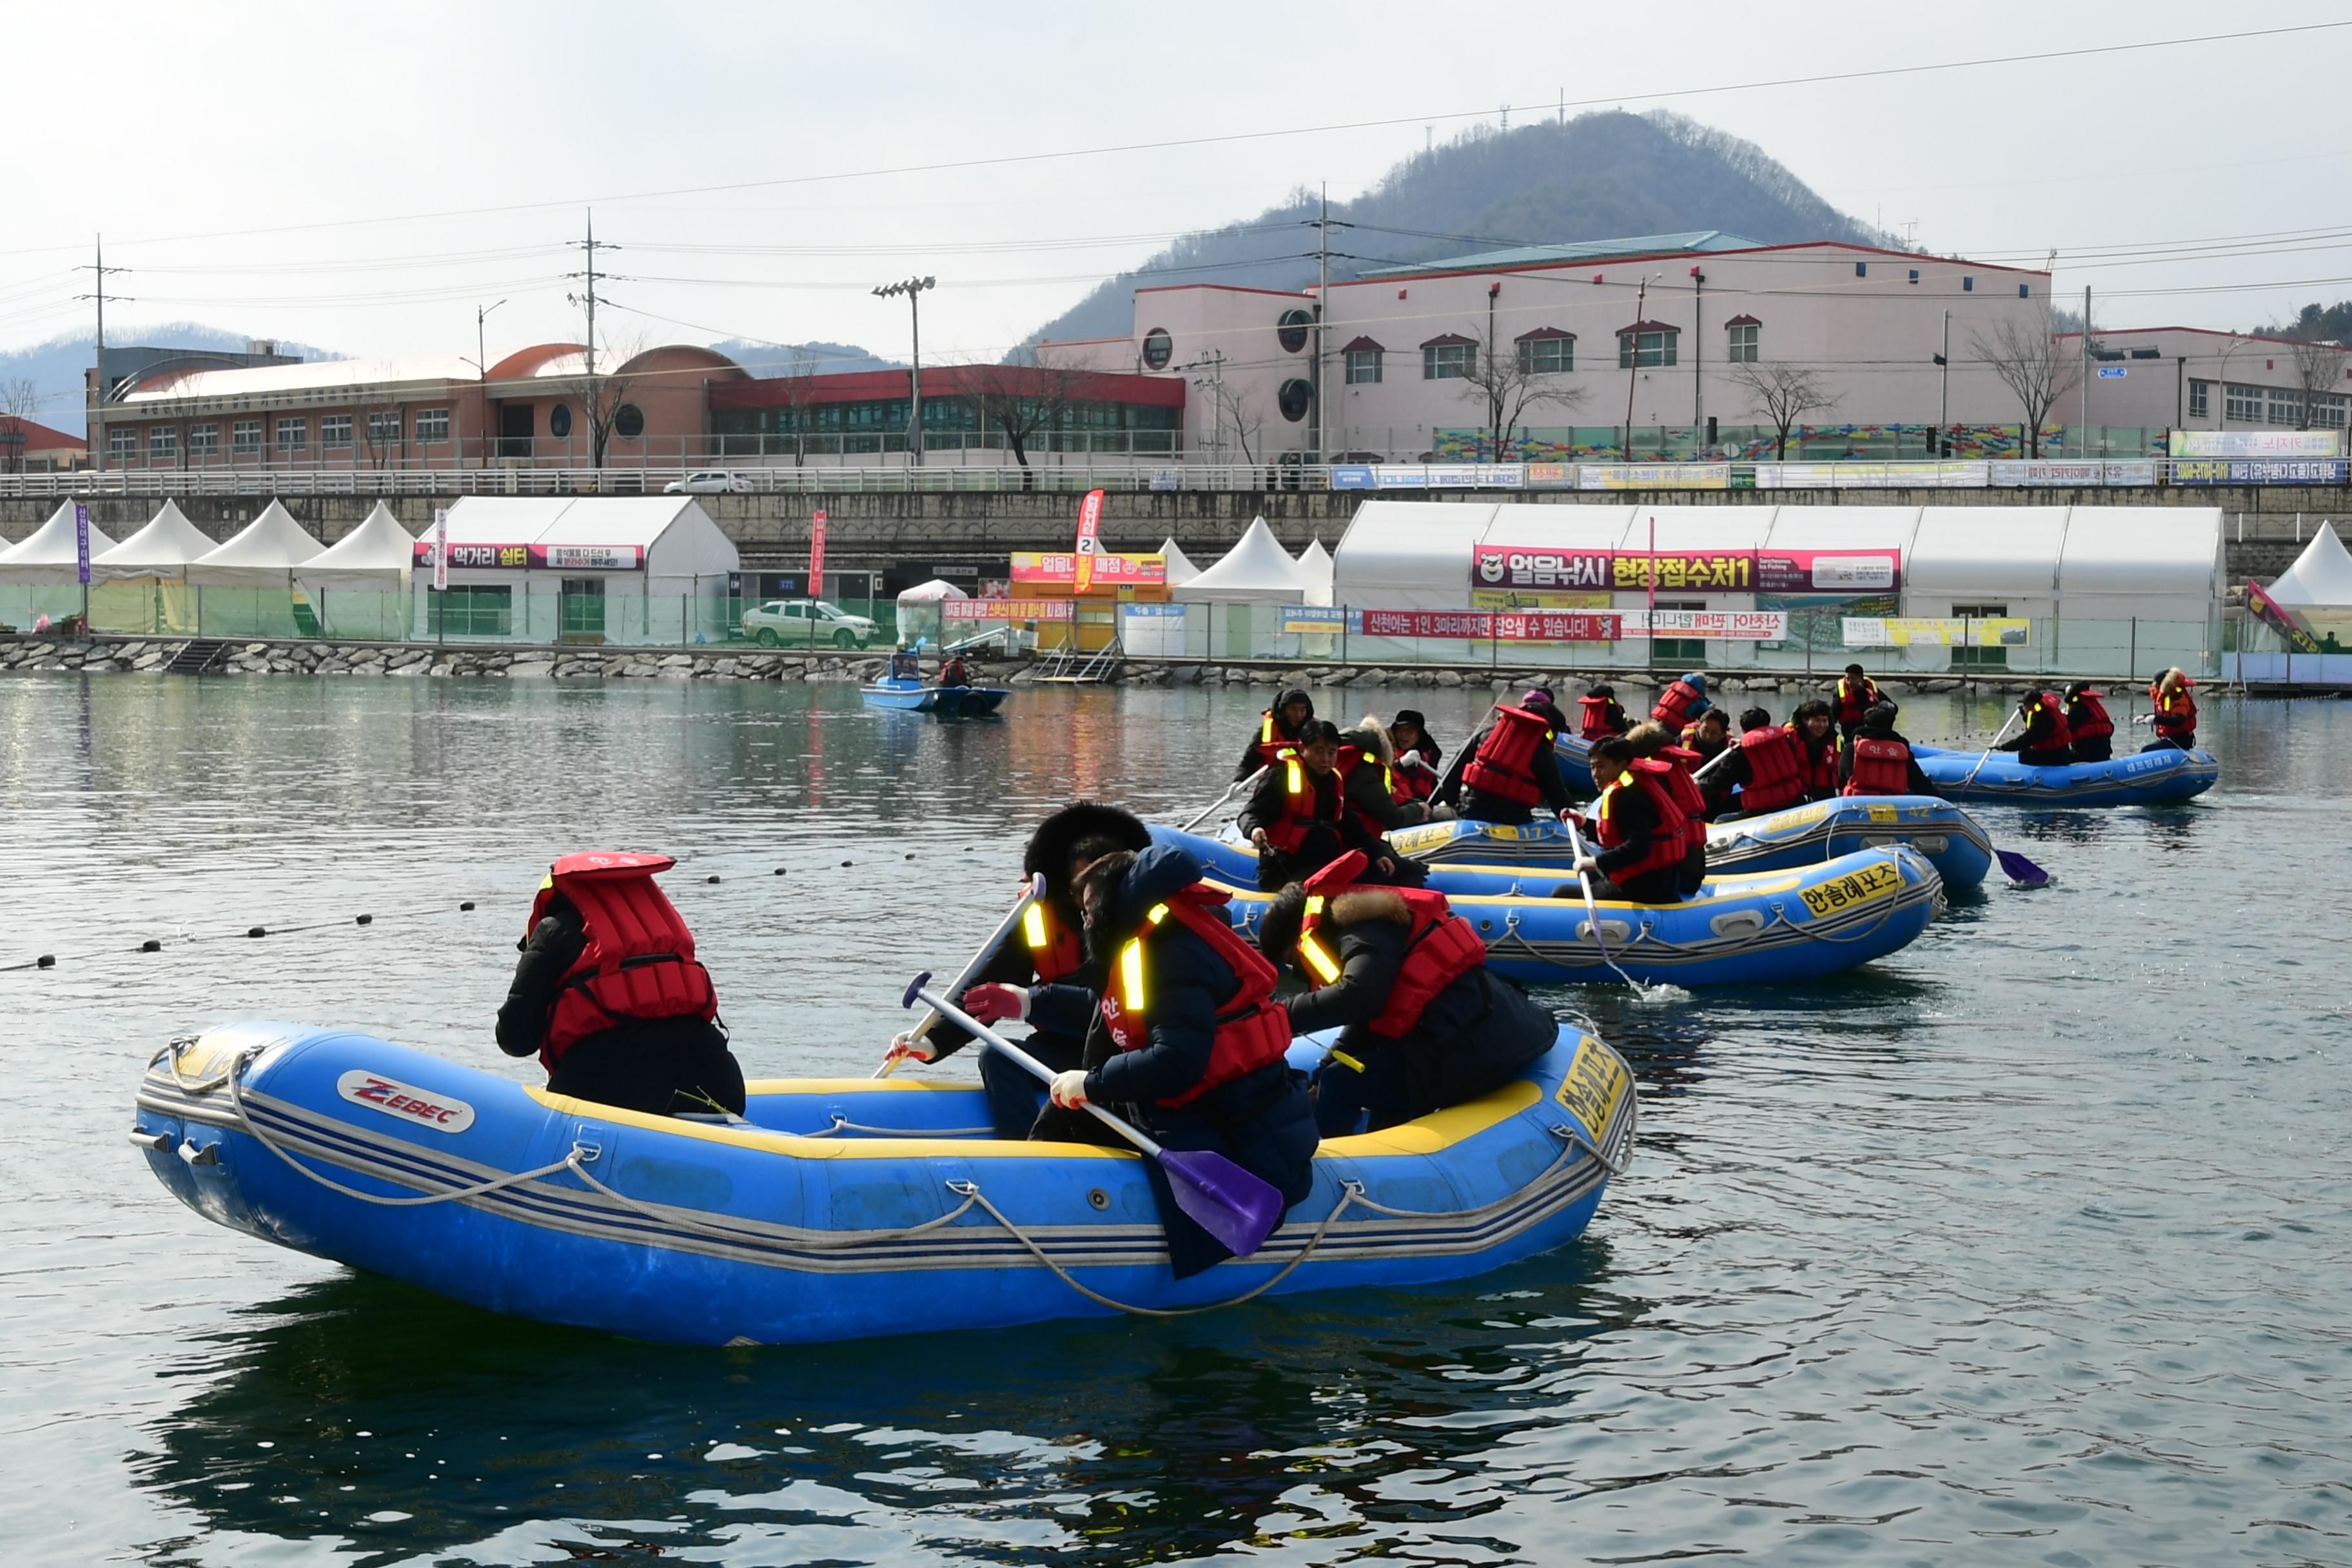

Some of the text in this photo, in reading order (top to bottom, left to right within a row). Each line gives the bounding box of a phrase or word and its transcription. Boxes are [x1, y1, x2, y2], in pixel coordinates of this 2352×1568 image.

[79, 507, 88, 570] 산천어구이터
[1081, 539, 1092, 552] 2
[454, 547, 527, 565] 먹거리 쉼터
[1096, 556, 1120, 573] 매점
[1509, 554, 1750, 587] 얼음낚시 현장접수처1
[1370, 613, 1411, 634] 산천어는
[1415, 614, 1431, 634] 1인
[1434, 615, 1491, 636] 3마리까지만
[1494, 616, 1526, 637] 잡으실
[1529, 619, 1540, 637] 수
[1544, 618, 1589, 638] 있습니다!
[1521, 827, 1542, 839] 17
[351, 1077, 460, 1124] ZEBEC
